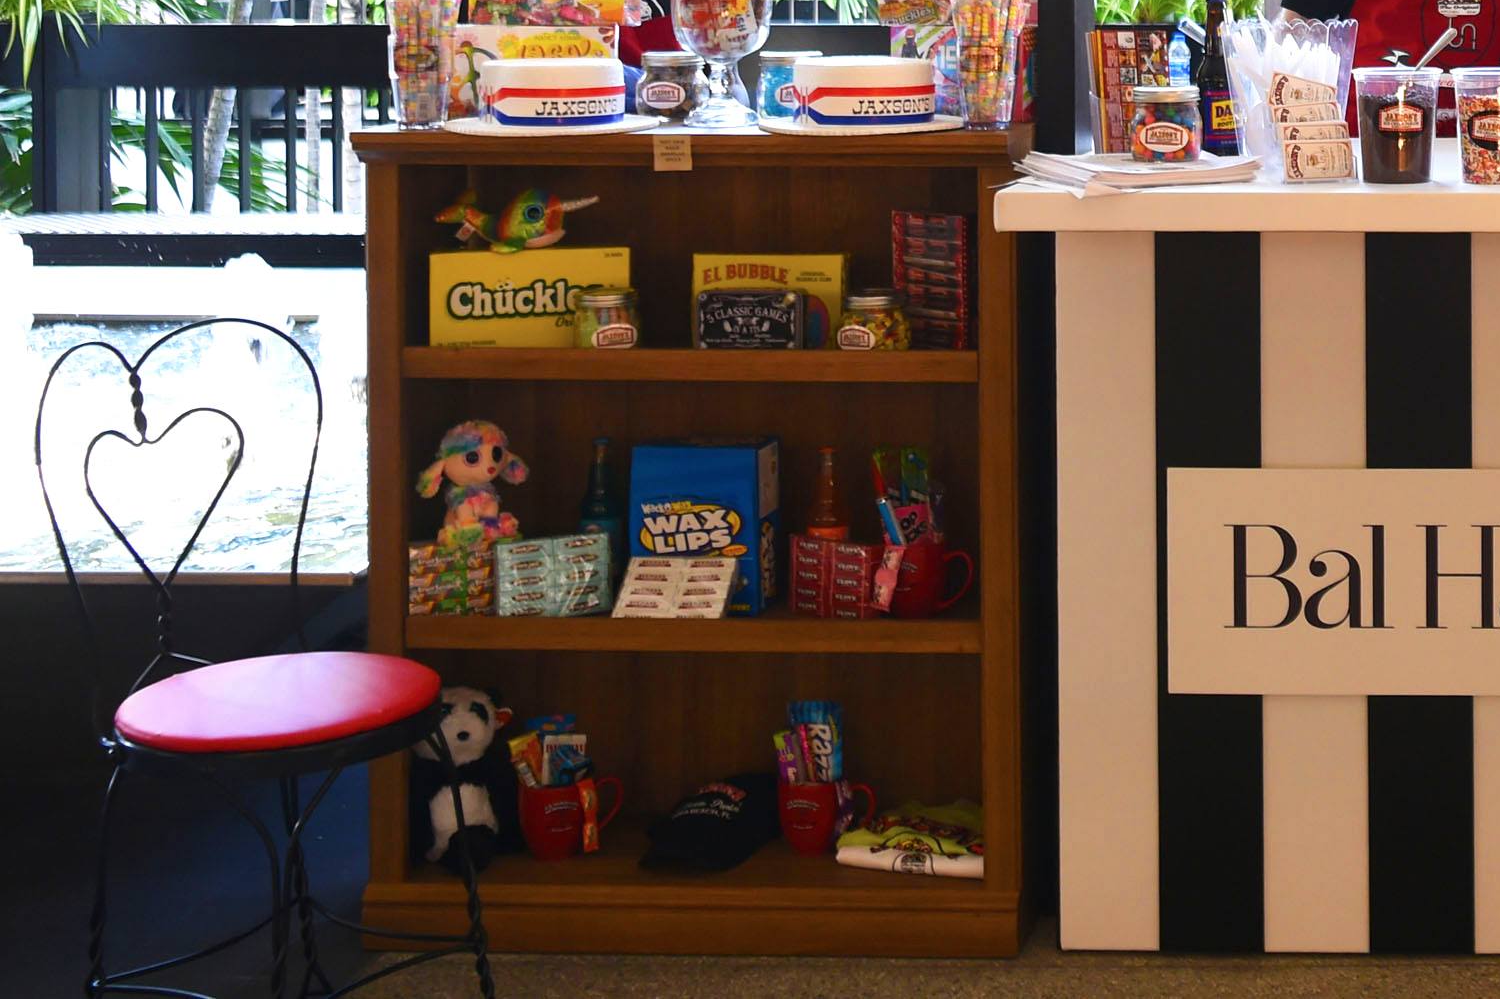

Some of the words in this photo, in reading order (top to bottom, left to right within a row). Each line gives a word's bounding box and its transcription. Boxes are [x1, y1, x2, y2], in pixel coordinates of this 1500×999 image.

[535, 97, 618, 117] JAXSON'S
[851, 96, 932, 116] JAXSON'S
[702, 266, 722, 286] EL
[725, 262, 790, 286] BUBBLE
[715, 306, 753, 320] CLASSIC
[755, 306, 790, 324] GAMES
[643, 509, 729, 535] WAX
[654, 529, 732, 554] LIPS
[1223, 522, 1395, 630] Bal
